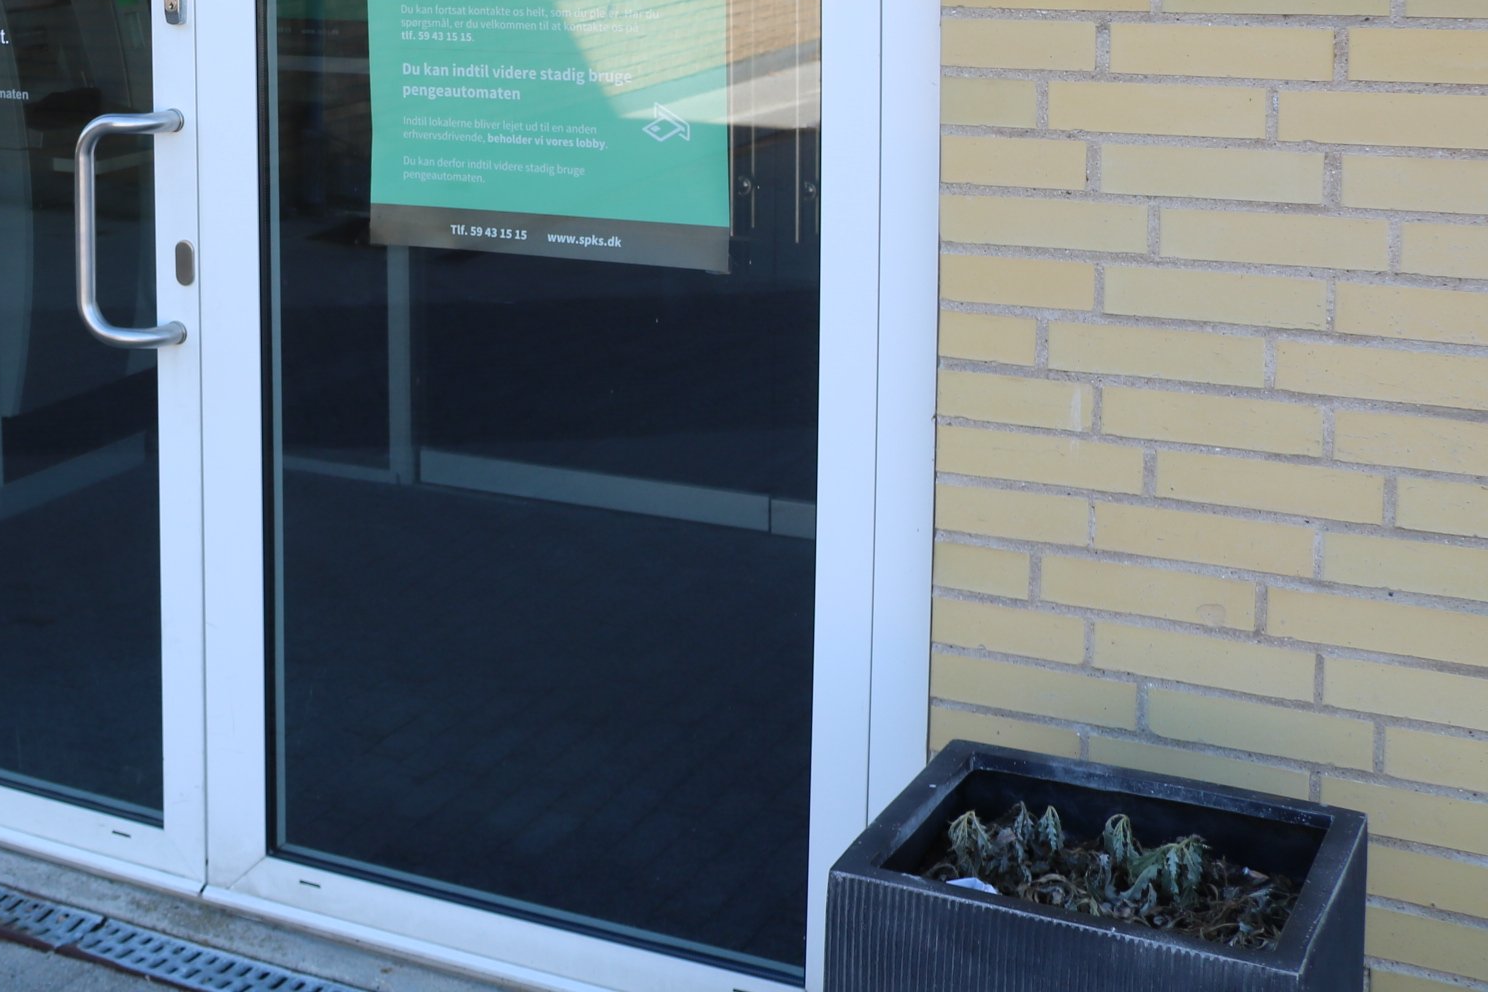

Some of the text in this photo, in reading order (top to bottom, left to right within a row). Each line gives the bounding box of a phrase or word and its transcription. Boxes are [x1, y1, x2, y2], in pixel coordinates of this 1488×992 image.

[400, 4, 414, 14] Du
[416, 4, 433, 14] kan
[435, 4, 466, 16] fortsat
[468, 6, 510, 16] kontakte
[512, 8, 524, 16] os
[526, 7, 548, 18] helt,
[550, 9, 572, 18] som
[400, 18, 452, 30] spørgsmål,
[454, 20, 464, 28] er
[466, 18, 478, 28] du
[480, 19, 537, 30] velkommen
[539, 20, 550, 30] til
[552, 22, 561, 31] at
[564, 22, 608, 32] kontakte
[402, 31, 416, 40] tlf.
[418, 32, 430, 40] 59
[432, 32, 444, 41] 43
[446, 32, 458, 41] 15
[402, 62, 632, 86] Du kan indtil videre stadig bruge
[402, 84, 520, 100] pengeautomaten
[403, 116, 597, 134] Indtil lokalerne bliver lejet ud til en anden
[404, 130, 608, 151] erhvervsdrivende, beholder vi vores lobby.
[403, 156, 586, 178] Du kan derfor indtil videre stadig bruge
[403, 170, 486, 184] pengeautomaten.
[450, 224, 622, 248] Tlf. 59 43 15 15 www.spks.dk
